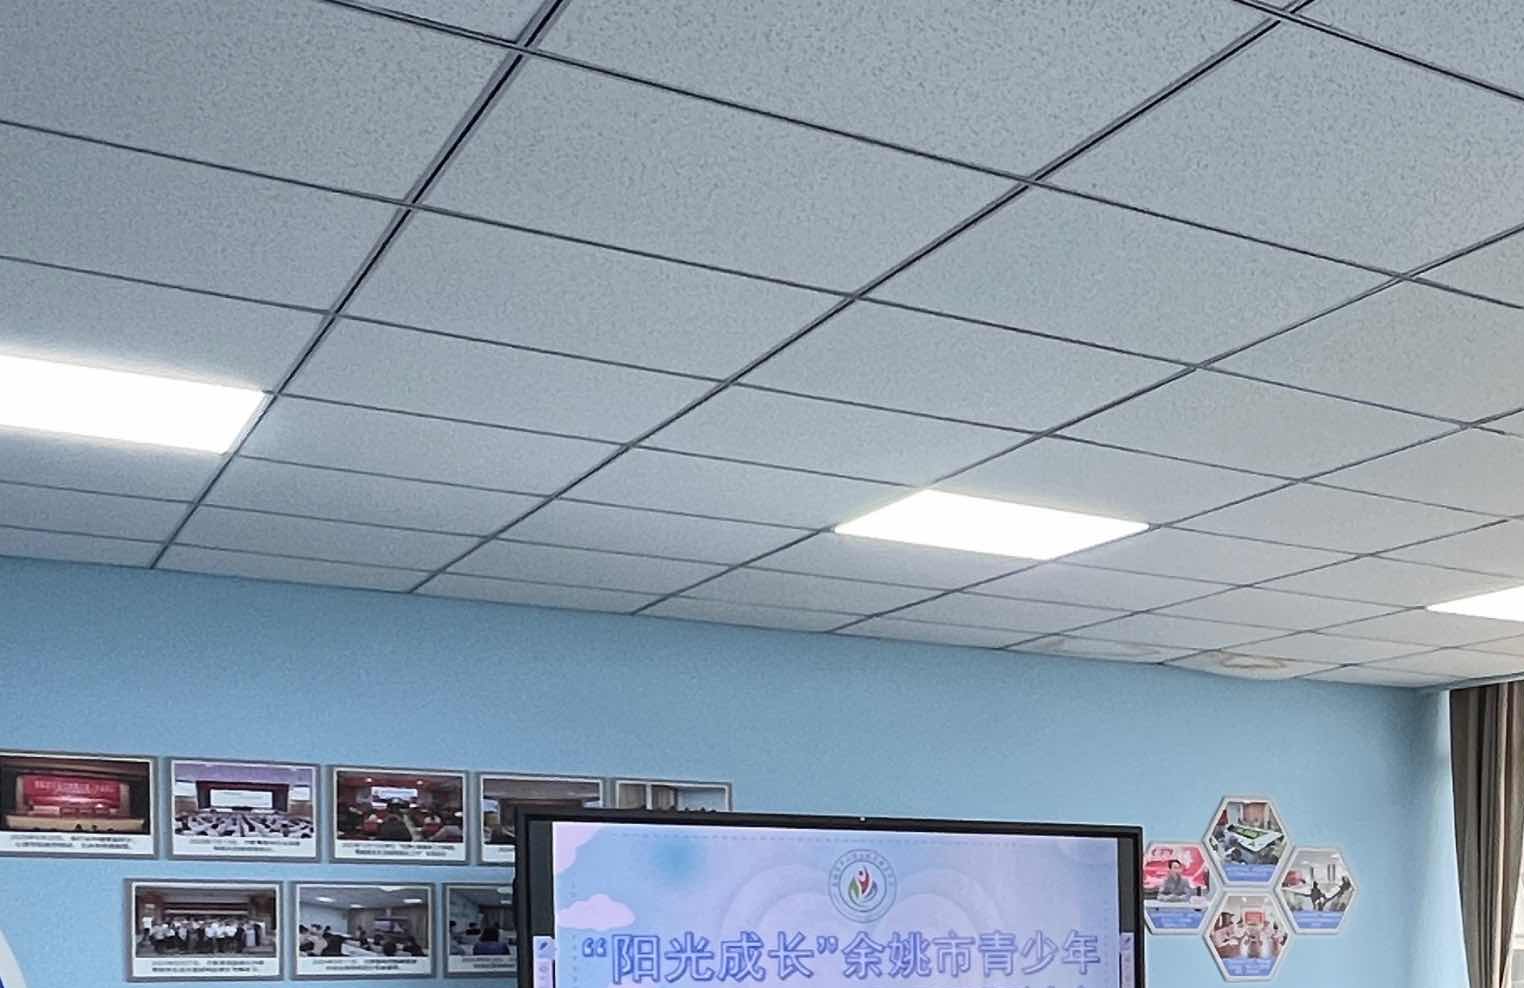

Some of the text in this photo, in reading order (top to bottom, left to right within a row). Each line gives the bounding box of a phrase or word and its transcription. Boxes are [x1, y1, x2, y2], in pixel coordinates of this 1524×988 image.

[582, 930, 1101, 985] “阳光成长”余姚市青少年
